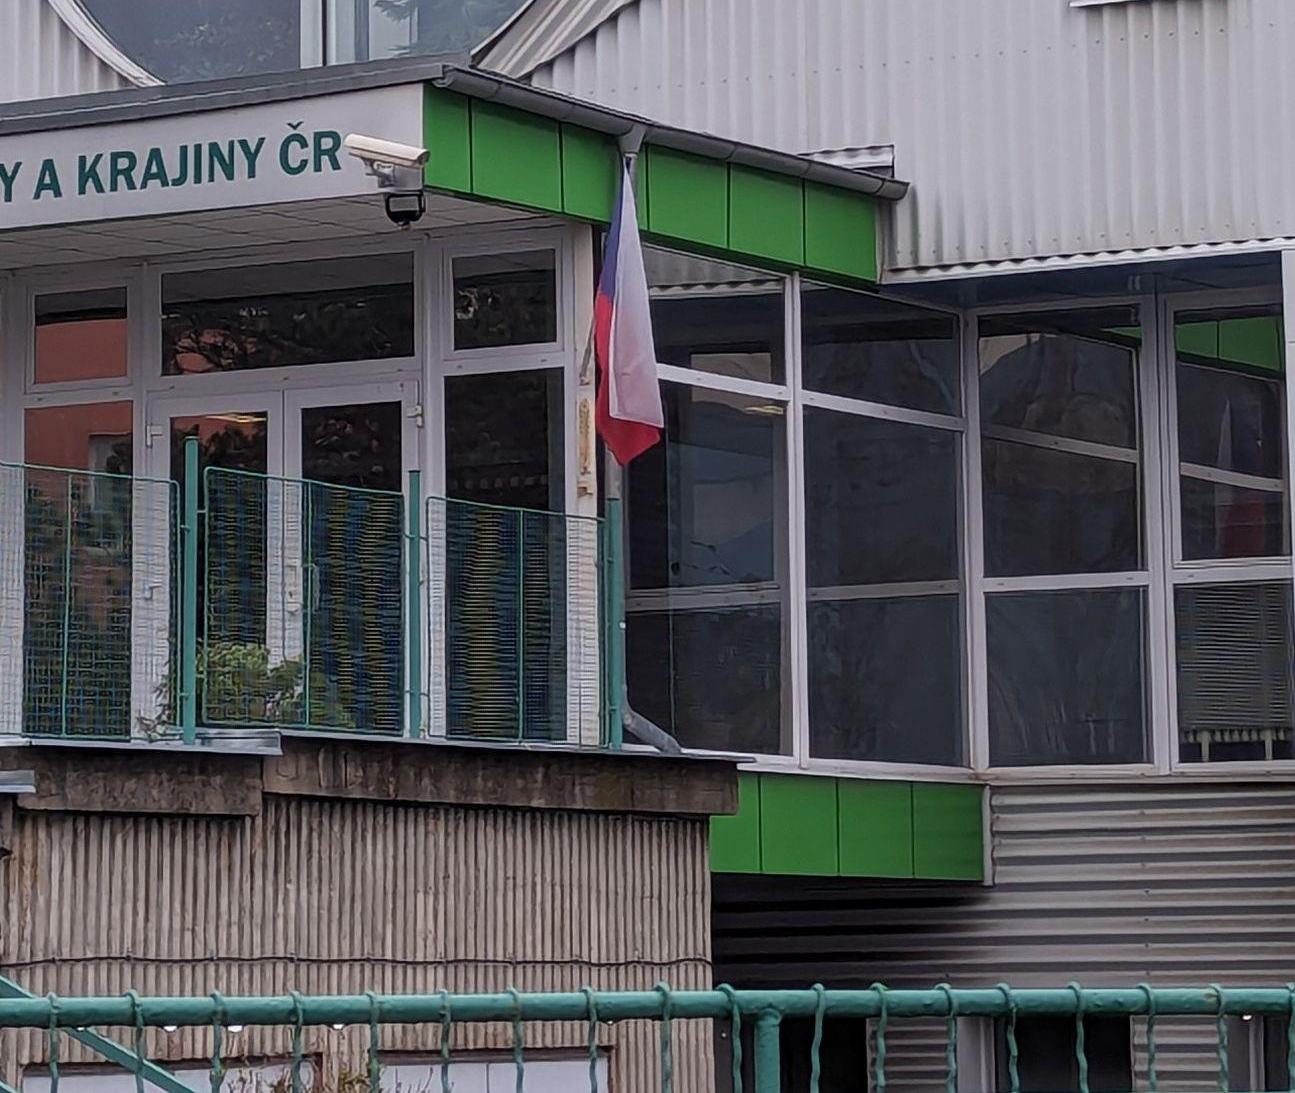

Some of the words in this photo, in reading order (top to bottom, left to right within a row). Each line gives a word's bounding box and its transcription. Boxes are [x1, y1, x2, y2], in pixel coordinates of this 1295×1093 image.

[34, 158, 62, 200] A
[77, 136, 266, 197] KRAJINY
[278, 121, 343, 177] ČR
